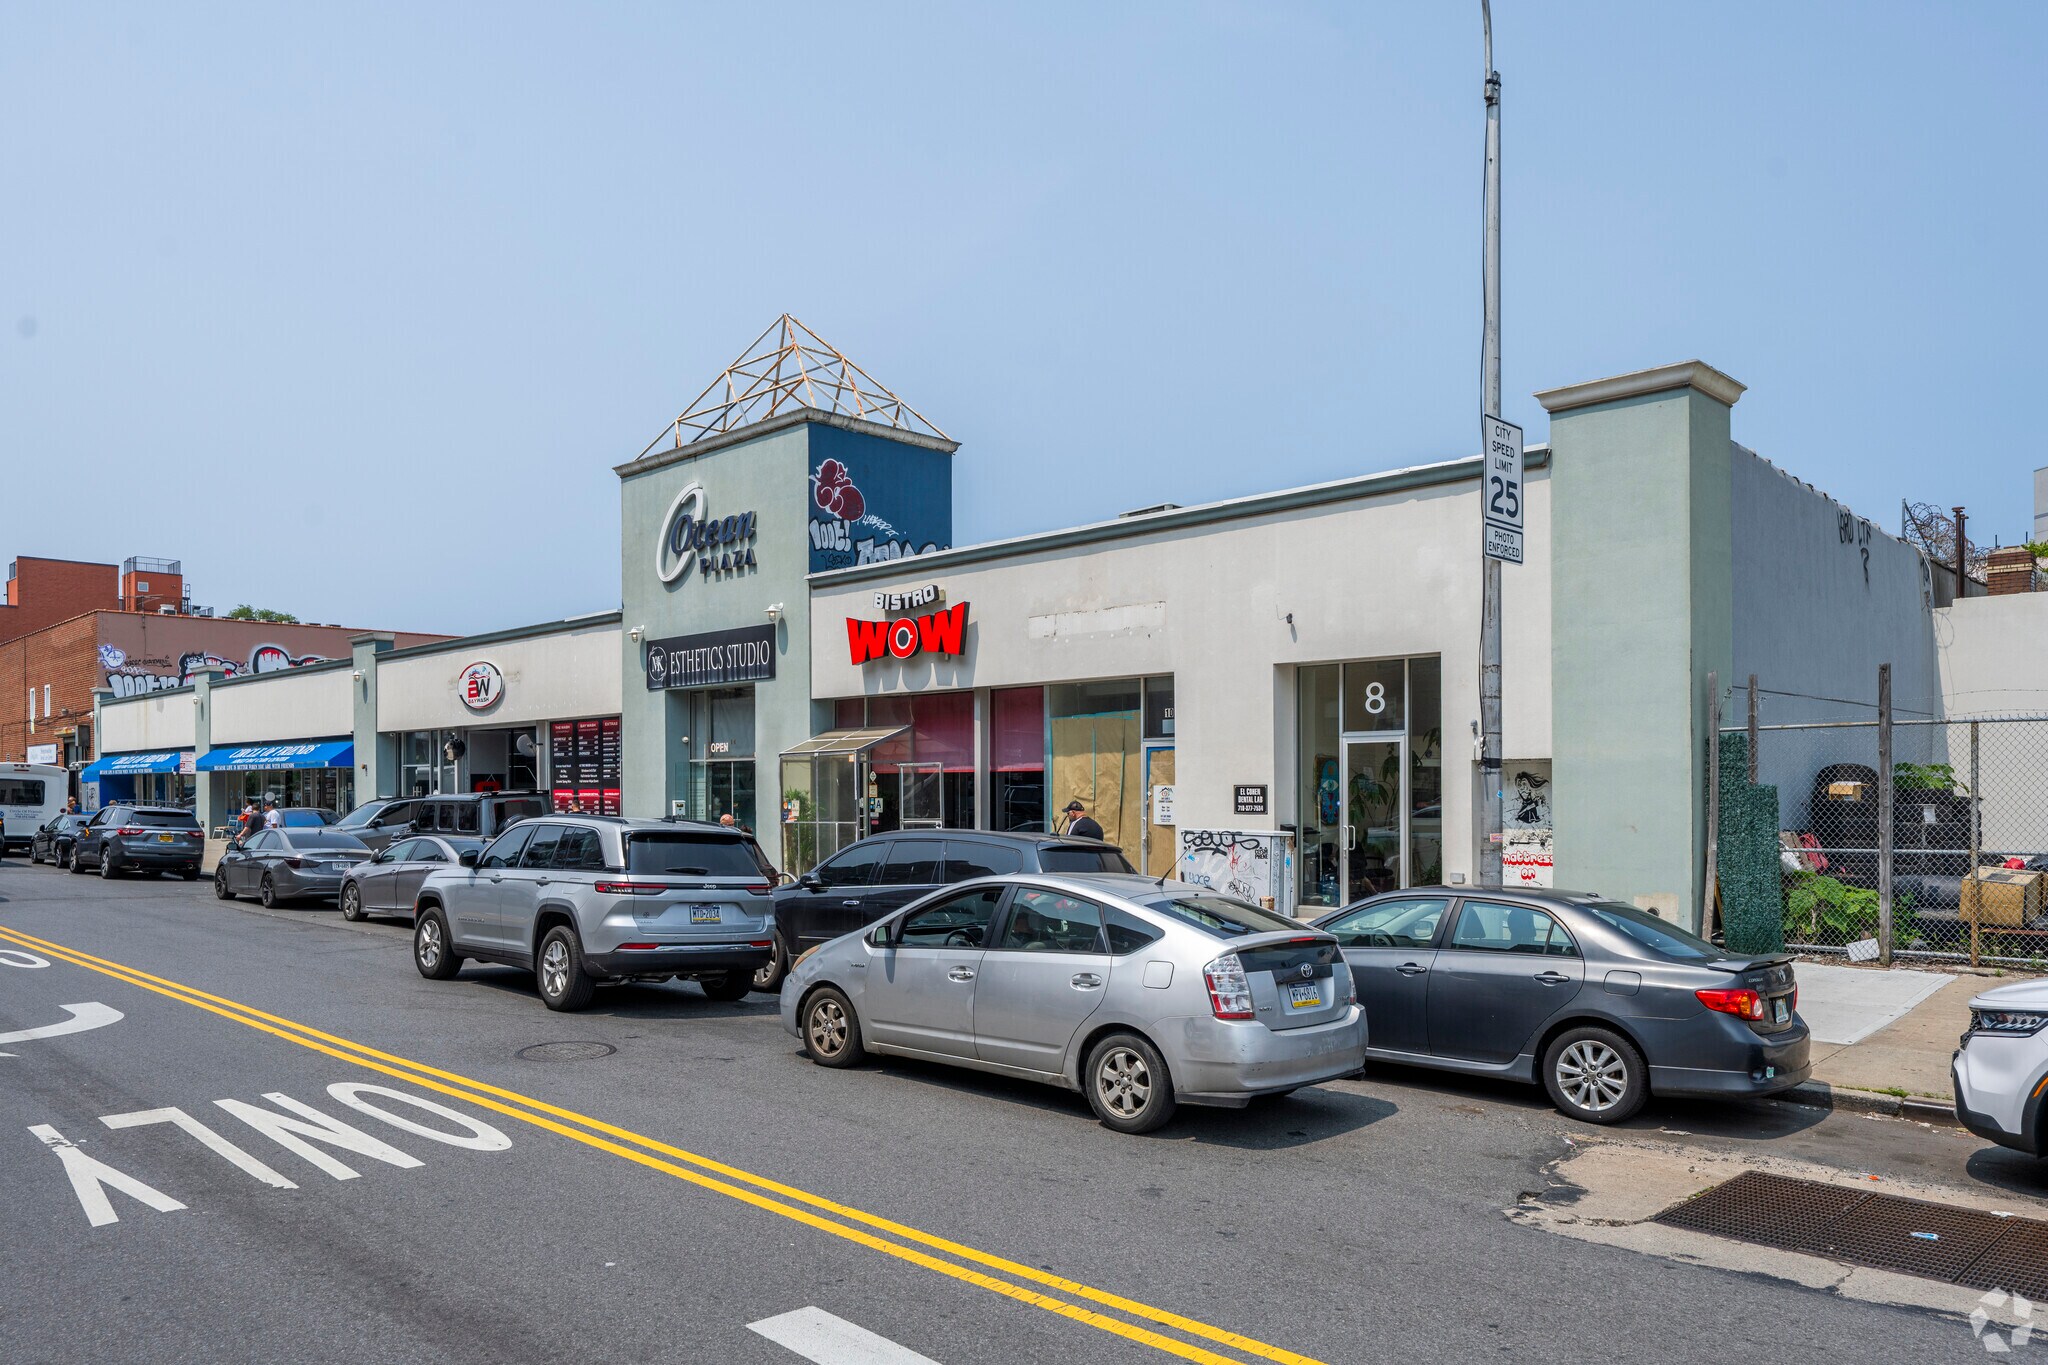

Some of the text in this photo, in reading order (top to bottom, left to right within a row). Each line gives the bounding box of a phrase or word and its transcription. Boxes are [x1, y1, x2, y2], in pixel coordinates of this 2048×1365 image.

[1495, 425, 1512, 442] CITY
[1492, 440, 1515, 458] SPEED
[1494, 458, 1512, 474] LIMIT
[1490, 476, 1518, 518] 25
[1494, 530, 1514, 544] PHOTO
[1488, 541, 1520, 558] ENFORCED
[700, 548, 758, 574] PLAZA
[873, 584, 938, 610] BISTRO
[846, 602, 969, 666] WOW
[670, 646, 724, 674] ESTHETICS
[726, 640, 770, 668] STUDIO
[1365, 682, 1386, 714] 8
[710, 742, 728, 752] OPEN
[1502, 850, 1553, 866] mattres
[27, 1082, 512, 1227] ONLY
